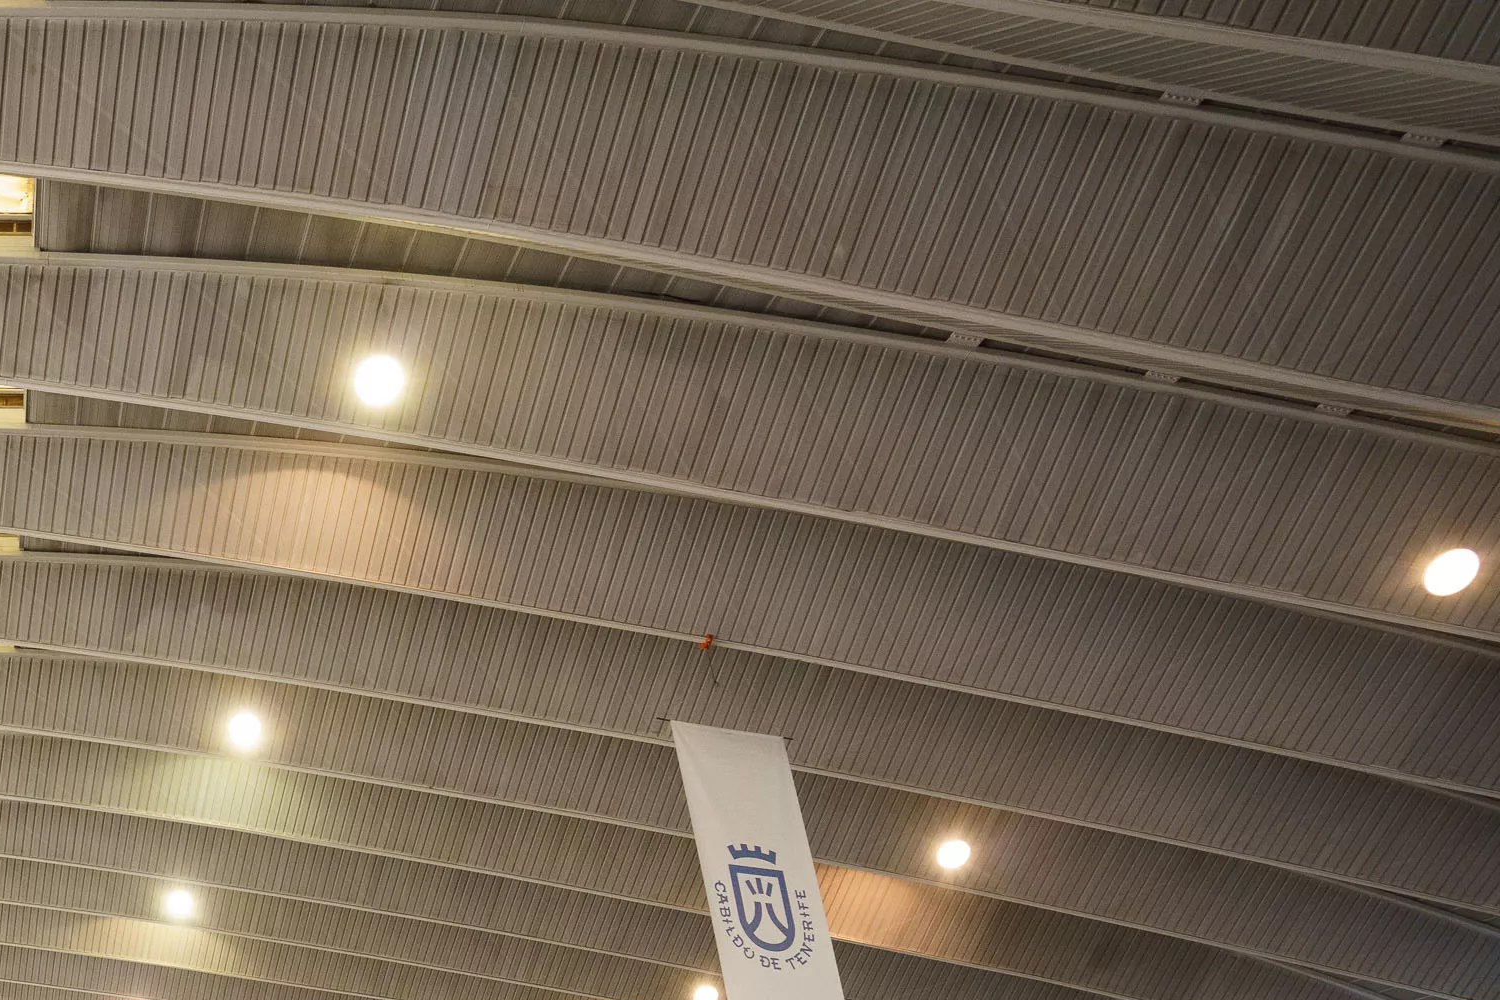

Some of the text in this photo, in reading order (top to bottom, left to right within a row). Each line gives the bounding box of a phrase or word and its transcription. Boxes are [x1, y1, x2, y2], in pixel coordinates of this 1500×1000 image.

[715, 880, 816, 971] CABILDO DE TENERIFE
